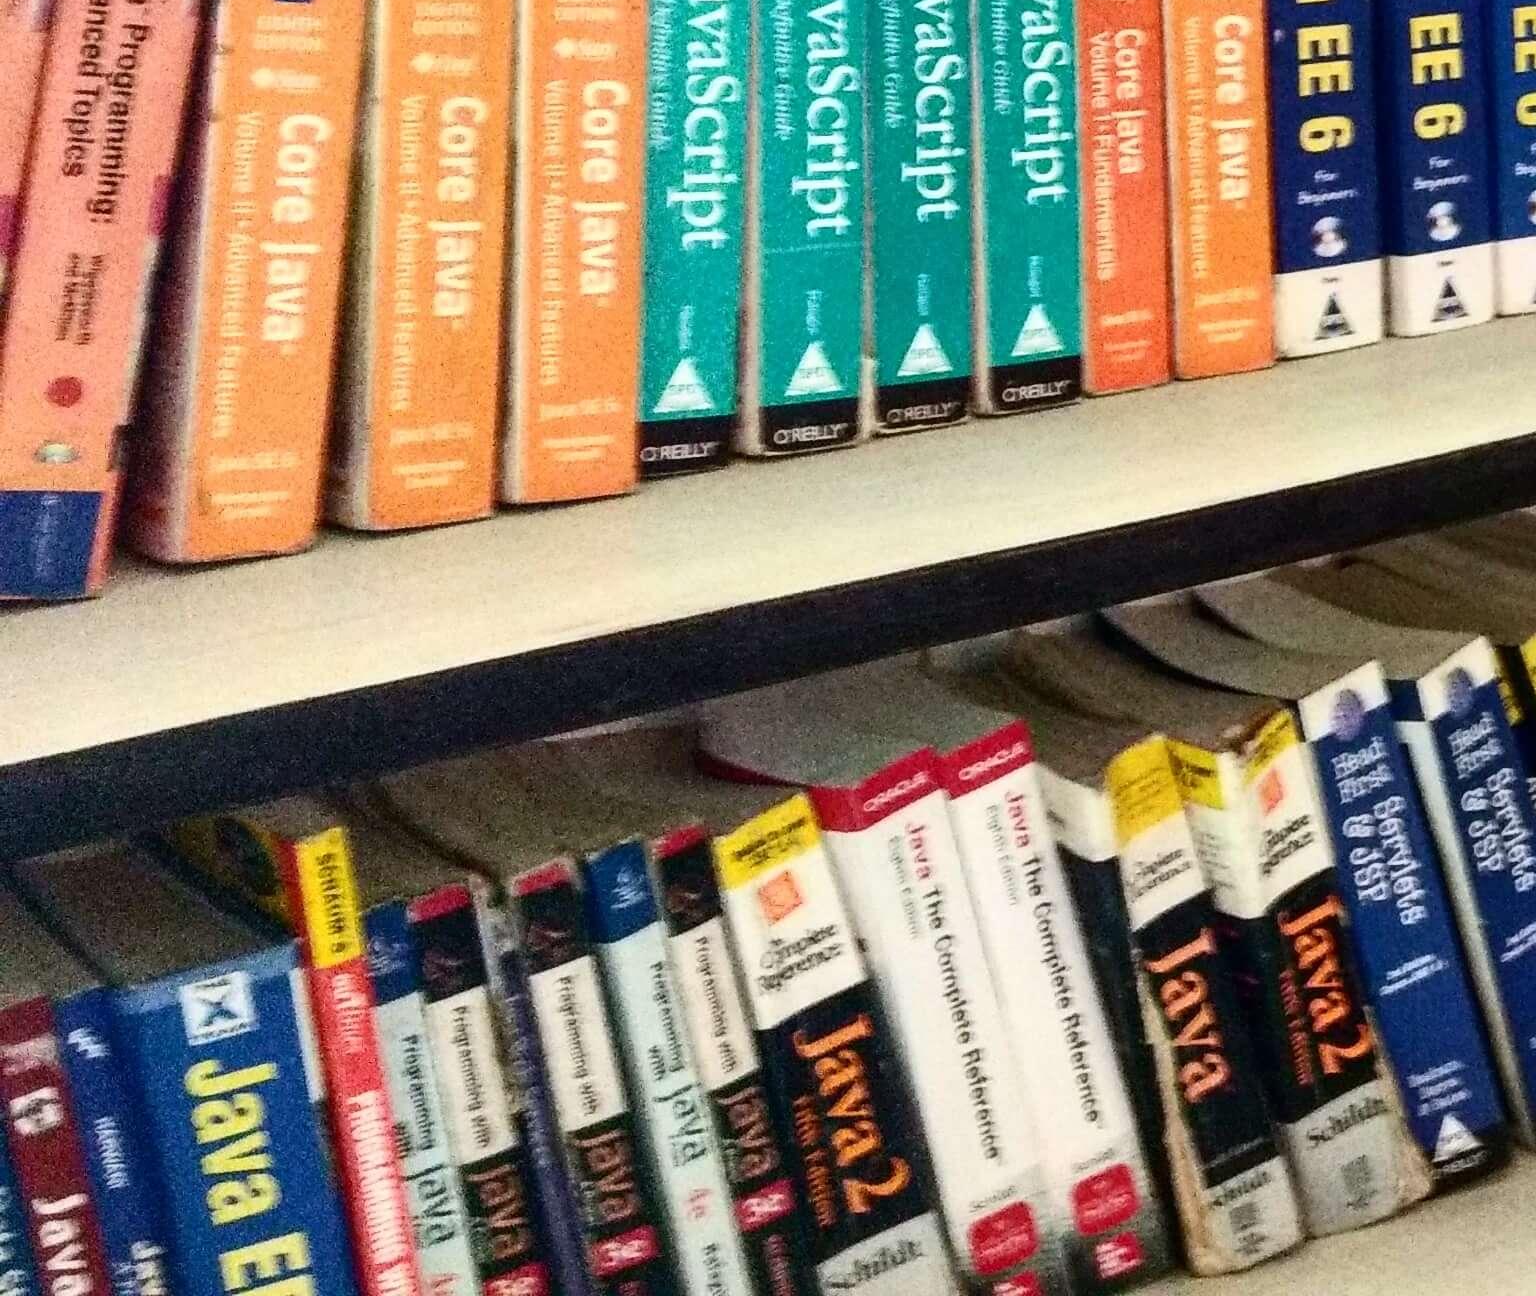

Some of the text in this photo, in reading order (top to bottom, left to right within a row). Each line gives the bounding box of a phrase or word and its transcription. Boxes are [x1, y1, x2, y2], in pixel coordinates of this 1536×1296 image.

[1089, 30, 1112, 111] Volume
[1111, 27, 1150, 176] Core Java
[1295, 23, 1354, 97] EE
[1409, 12, 1465, 86] EE
[434, 95, 490, 203] Core
[580, 79, 631, 185] Core
[1210, 14, 1257, 202] Core Java
[1298, 114, 1356, 153] 6
[1413, 102, 1468, 141] 6
[271, 113, 335, 224] Core
[258, 241, 323, 344] Java
[426, 220, 484, 318] Java
[572, 201, 629, 297] Java
[904, 822, 943, 932] Java The
[1003, 790, 1042, 899] Java The
[1349, 846, 1393, 903] JSP
[1372, 795, 1429, 926] Servlets
[1467, 819, 1506, 873] JSP
[1143, 927, 1231, 1104] Java
[1278, 895, 1373, 1075] Java 2
[184, 1059, 282, 1226] Java
[792, 1012, 913, 1216] Java 2
